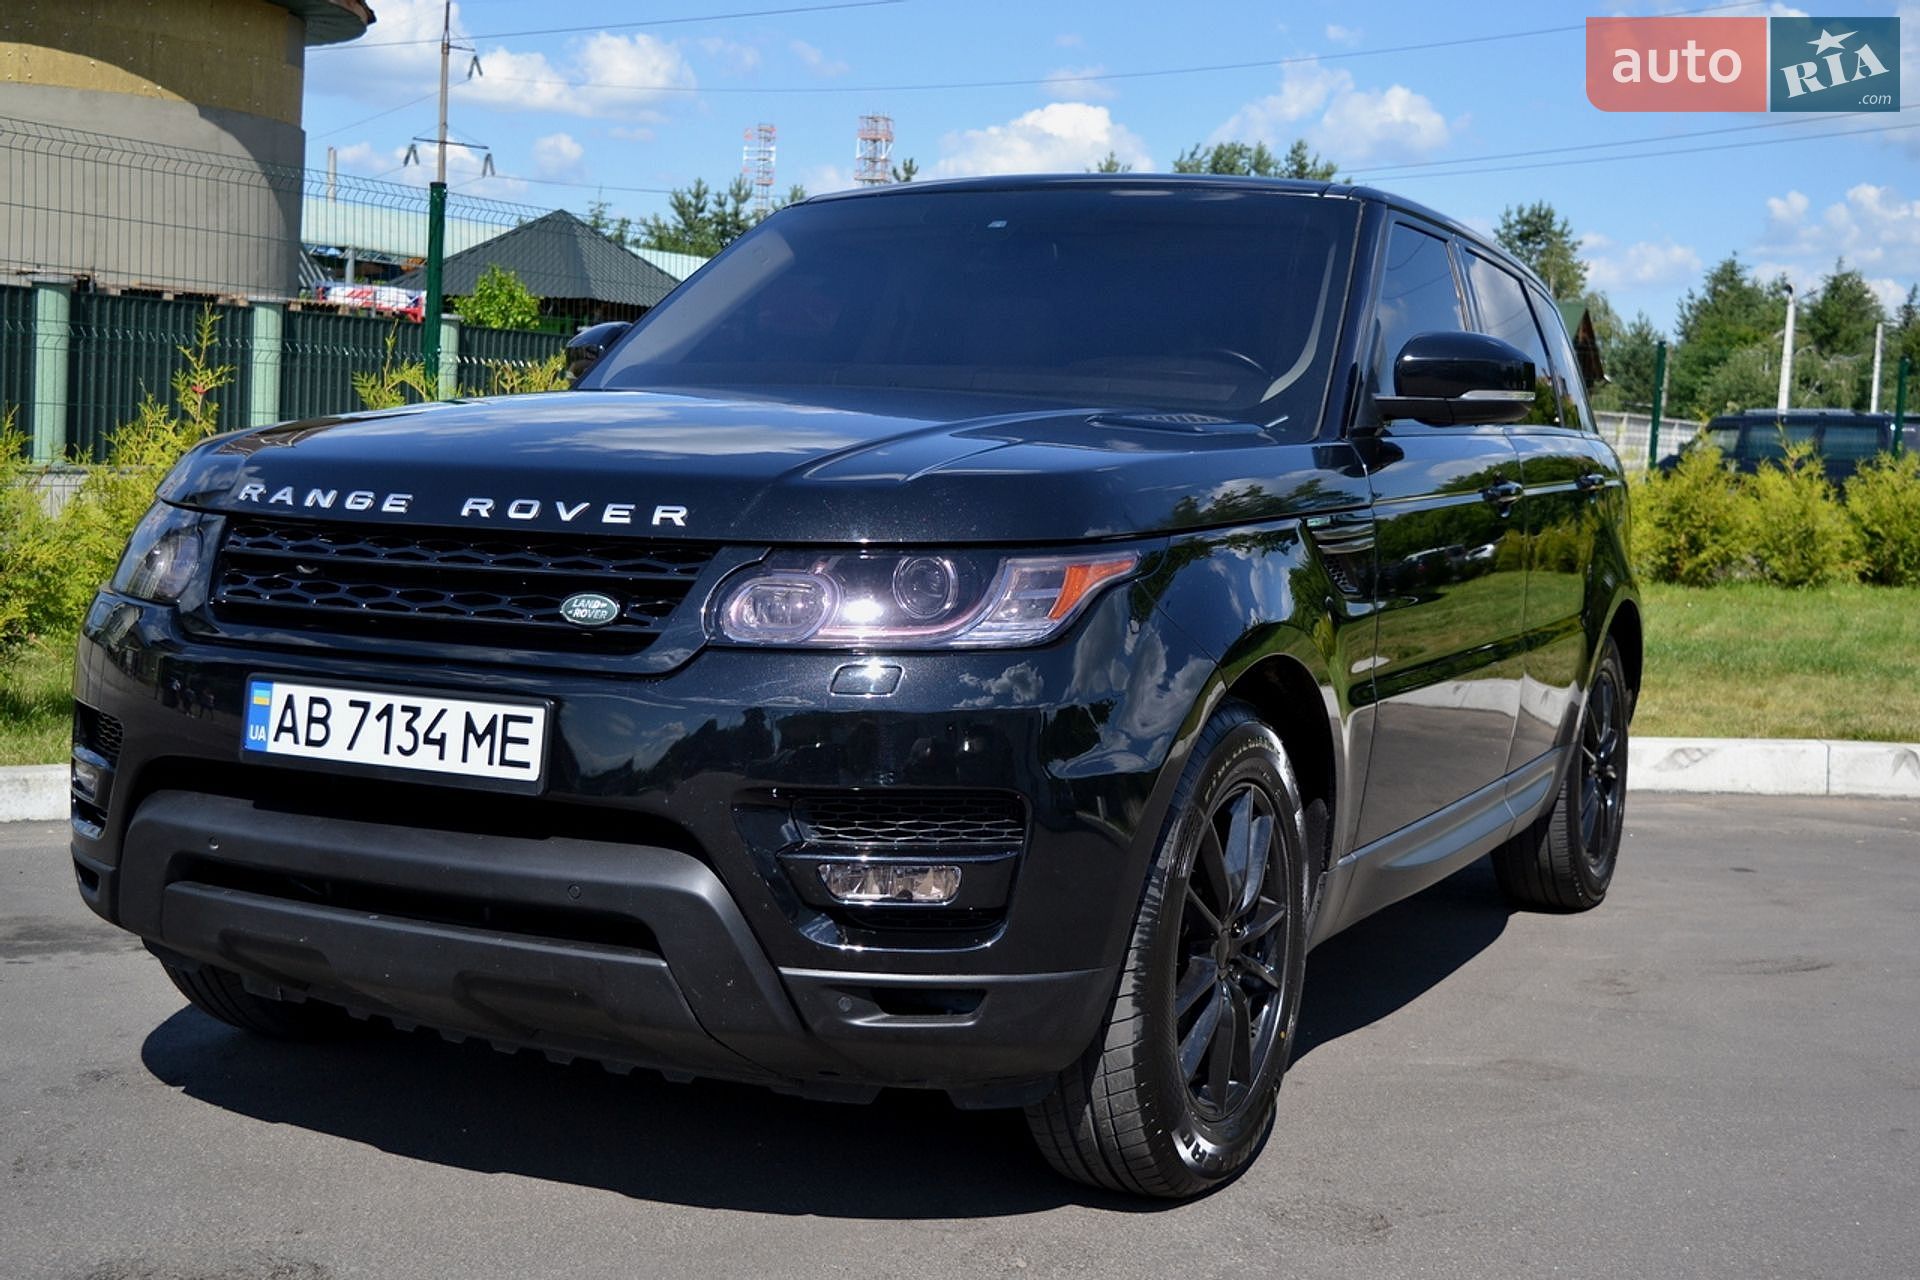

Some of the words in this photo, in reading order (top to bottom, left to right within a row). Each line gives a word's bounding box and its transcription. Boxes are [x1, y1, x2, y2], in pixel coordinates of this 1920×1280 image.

[238, 483, 413, 513] RANGE
[461, 497, 688, 527] ROVER
[250, 724, 266, 741] UA
[273, 694, 332, 747] AB
[347, 699, 448, 761] 7134
[461, 711, 533, 769] ME
